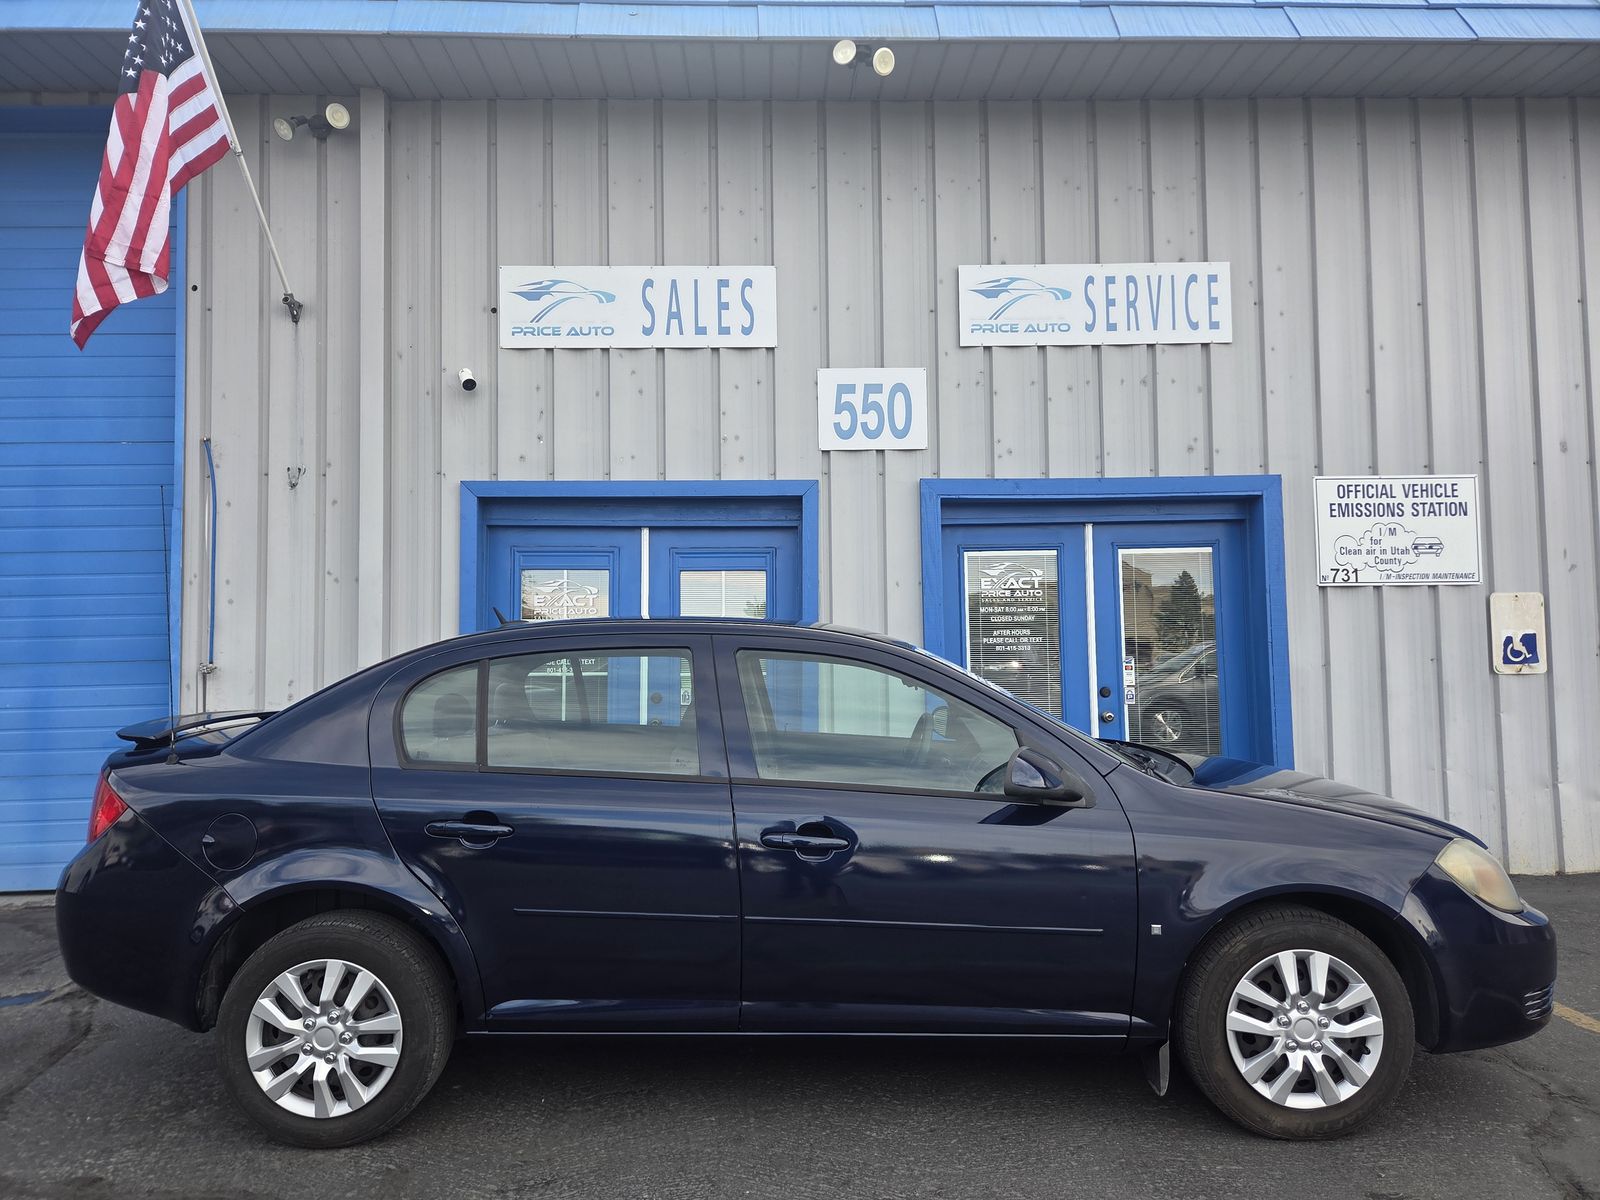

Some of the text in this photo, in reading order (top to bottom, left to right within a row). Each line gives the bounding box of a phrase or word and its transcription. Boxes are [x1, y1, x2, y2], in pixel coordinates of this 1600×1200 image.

[641, 278, 755, 337] SALES
[1084, 273, 1220, 333] SERVICE
[511, 326, 615, 337] PRICE AUTO
[971, 322, 1071, 333] PRICE AUTO
[833, 382, 913, 440] 550
[1336, 483, 1459, 499] OFFICIAL VEHICLE
[1329, 501, 1468, 518] EMISSIONS STATION
[1370, 537, 1382, 546] for
[1339, 546, 1410, 556] Clean air in Utah
[1374, 555, 1402, 566] County
[1330, 568, 1359, 583] 731
[1431, 572, 1476, 580] MAINTENANCE
[980, 577, 1043, 589] EXACT
[1013, 589, 1043, 597] AUTO
[533, 594, 598, 607] EXACT
[567, 607, 597, 615] AUTO
